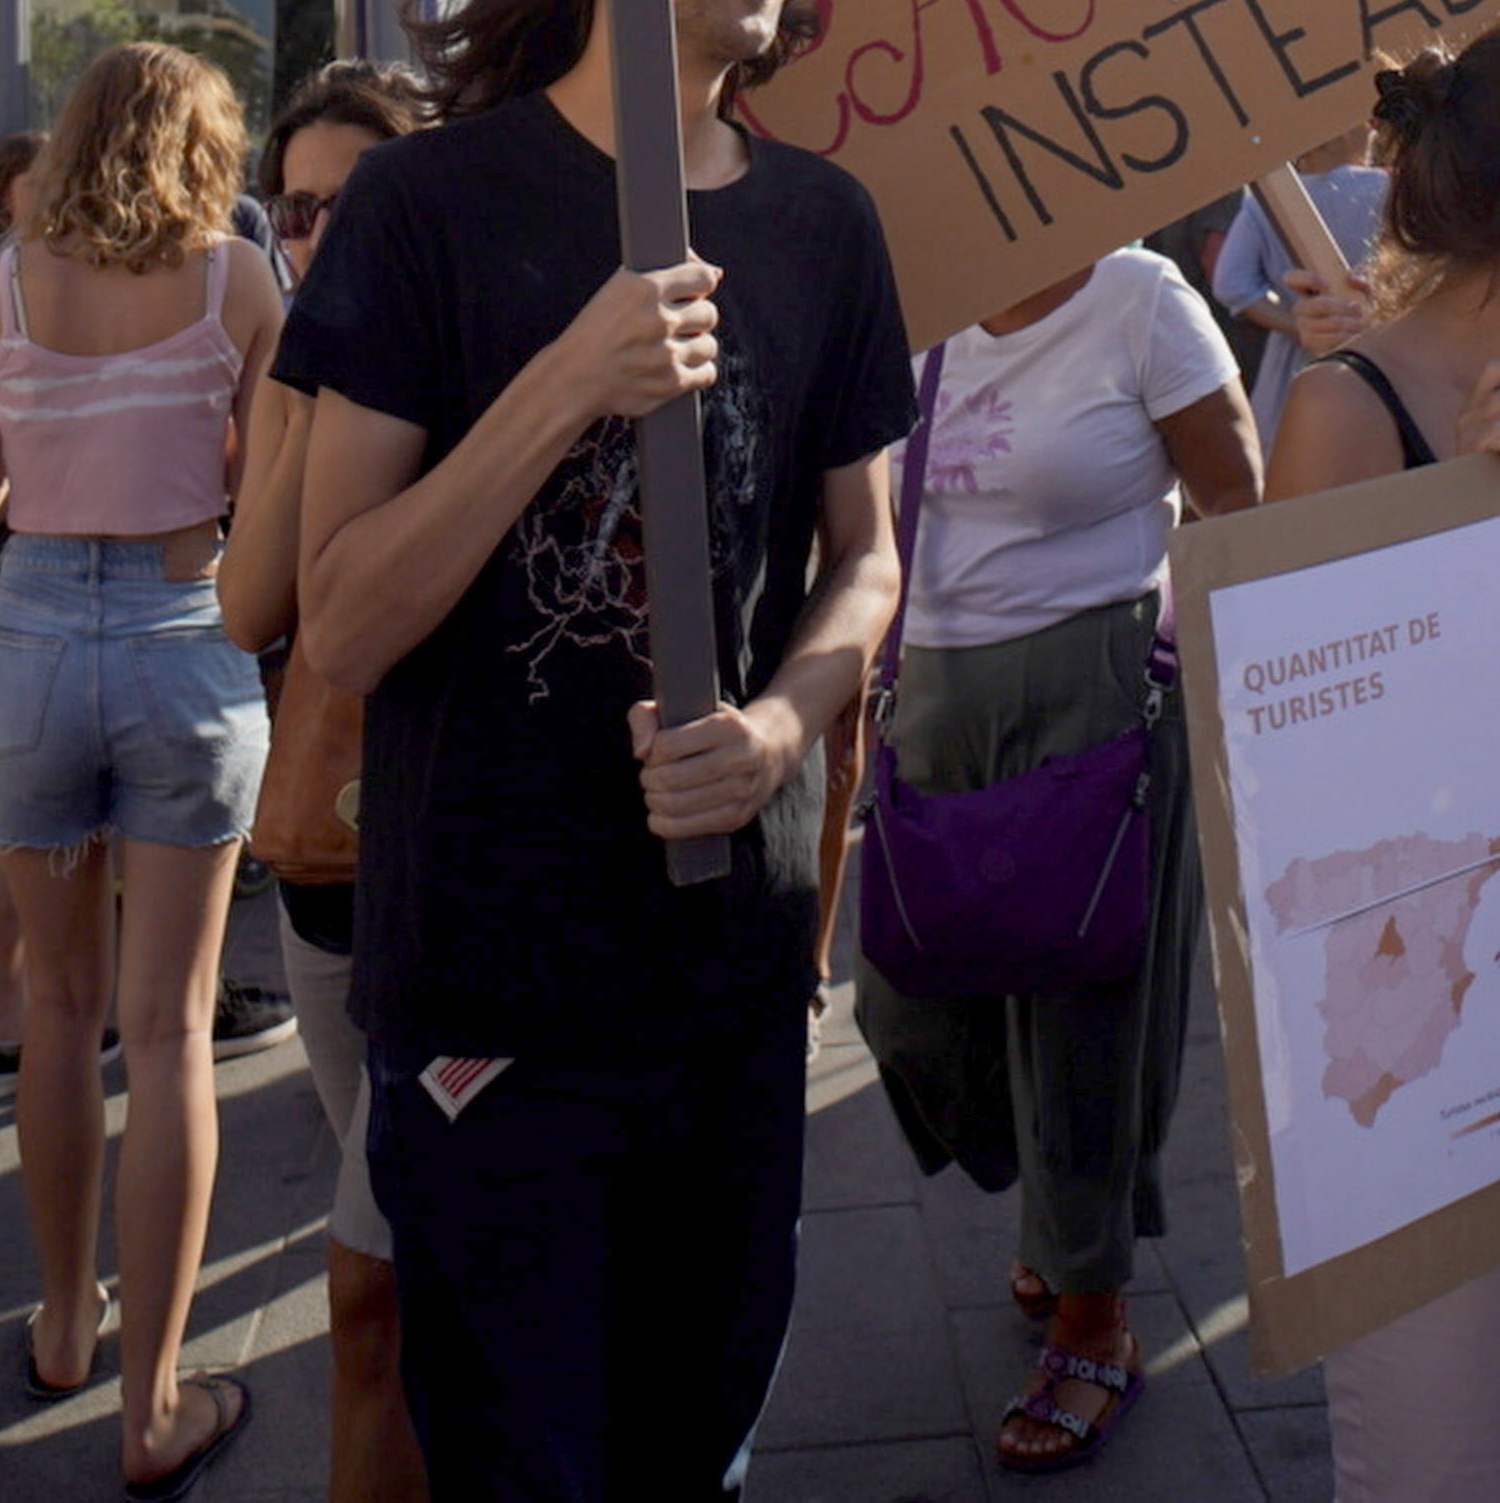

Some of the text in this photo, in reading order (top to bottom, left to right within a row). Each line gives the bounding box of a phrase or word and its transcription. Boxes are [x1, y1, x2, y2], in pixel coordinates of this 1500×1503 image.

[1243, 612, 1441, 695] QUANTITAT DE
[1246, 671, 1386, 735] TURISTES
